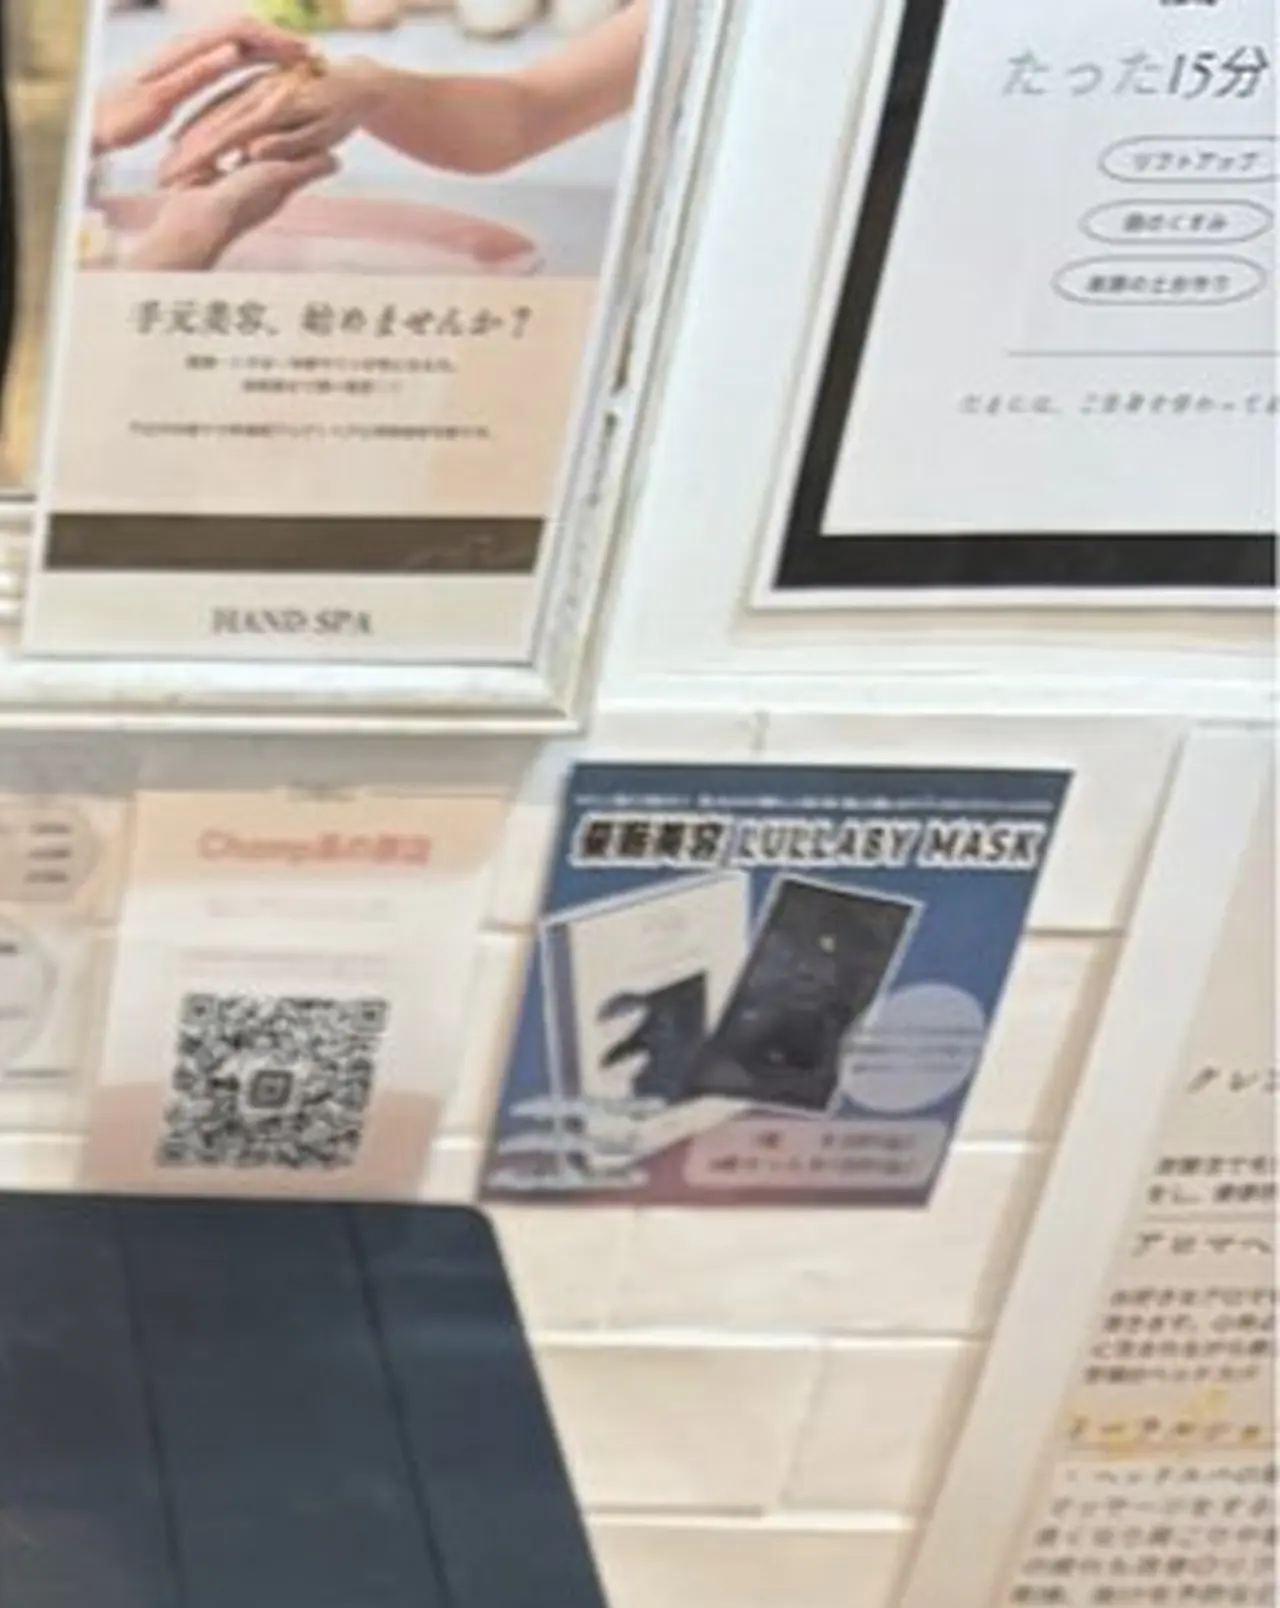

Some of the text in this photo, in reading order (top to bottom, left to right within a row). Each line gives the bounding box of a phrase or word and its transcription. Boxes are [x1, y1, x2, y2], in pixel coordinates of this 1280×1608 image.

[1001, 46, 1269, 99] たった15分
[740, 820, 913, 862] LULLABY
[926, 821, 1042, 862] MASK
